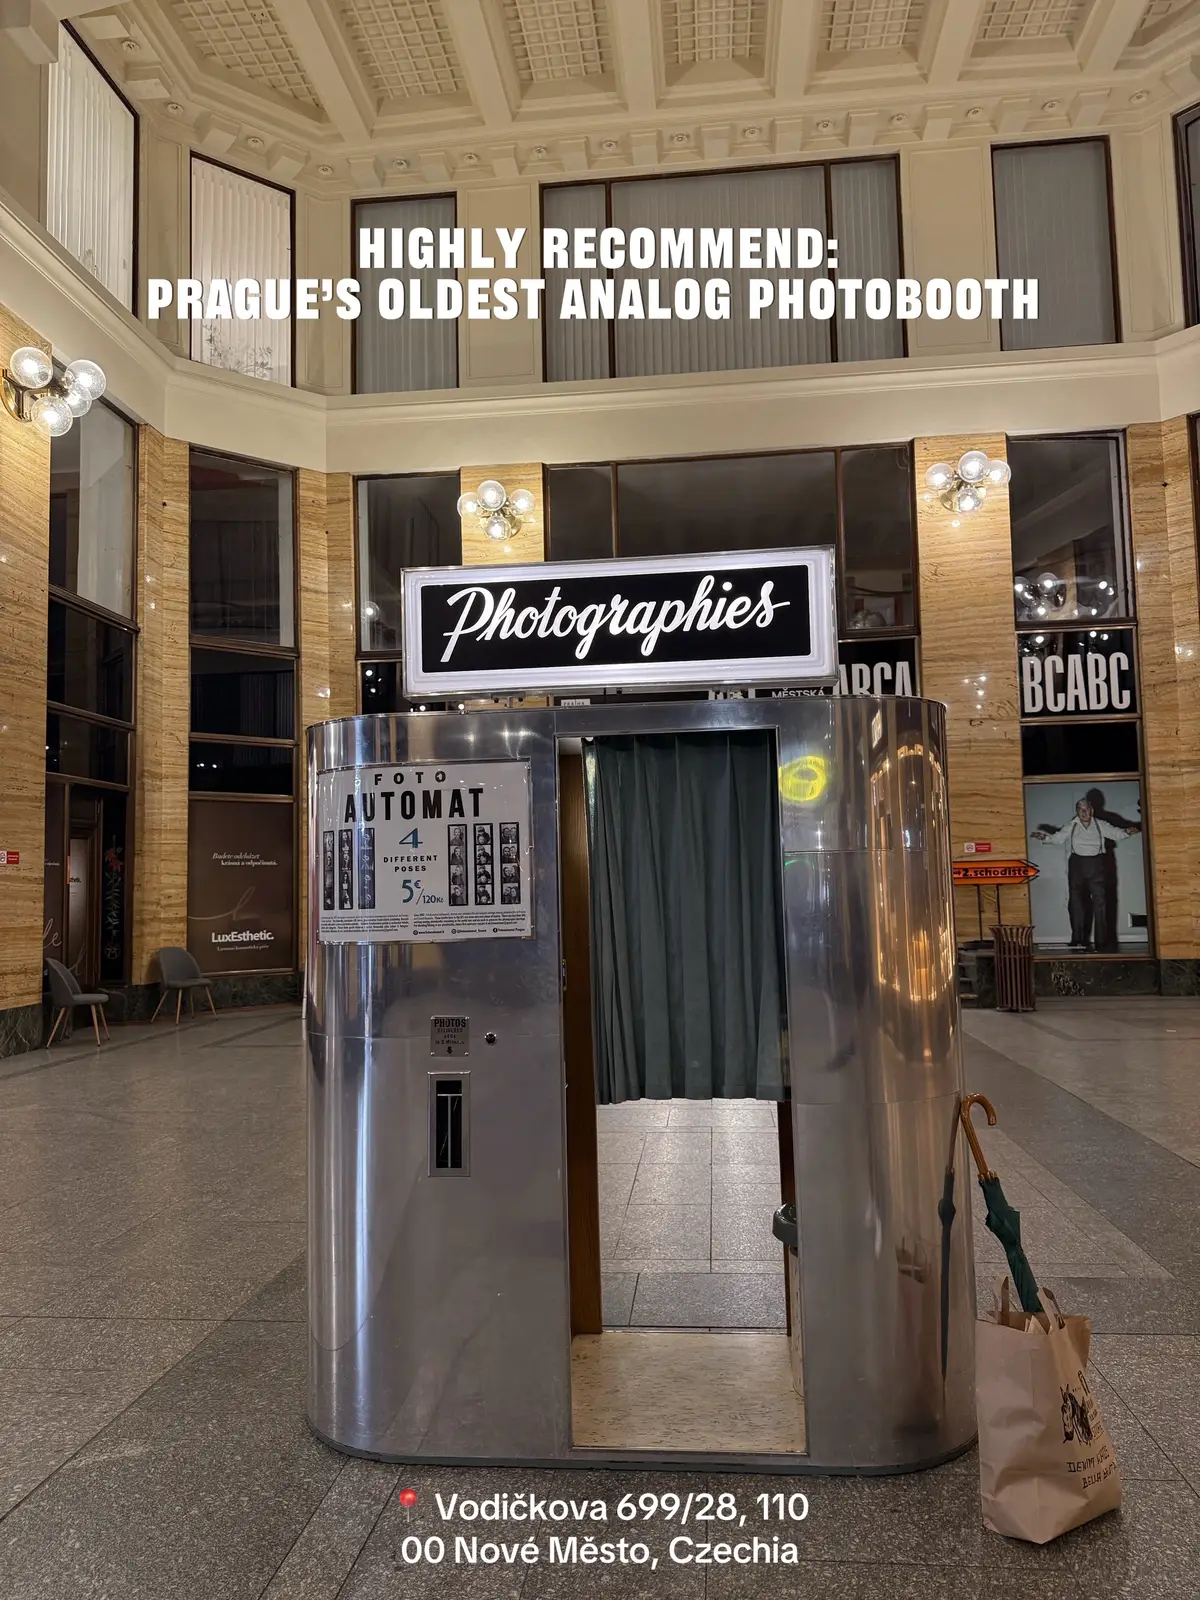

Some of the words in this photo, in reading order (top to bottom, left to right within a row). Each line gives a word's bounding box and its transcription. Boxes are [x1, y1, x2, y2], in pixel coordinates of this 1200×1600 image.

[440, 574, 791, 660] Photographies
[1022, 652, 1131, 713] BCABC
[374, 770, 446, 786] FOTO
[344, 788, 484, 823] AUTOMAT
[399, 828, 423, 848] 4
[384, 854, 438, 863] DIFFERENT
[211, 930, 275, 943] LuxEsthetic.
[434, 1018, 466, 1028] PHOTOS
[1066, 1457, 1096, 1473] DENIM
